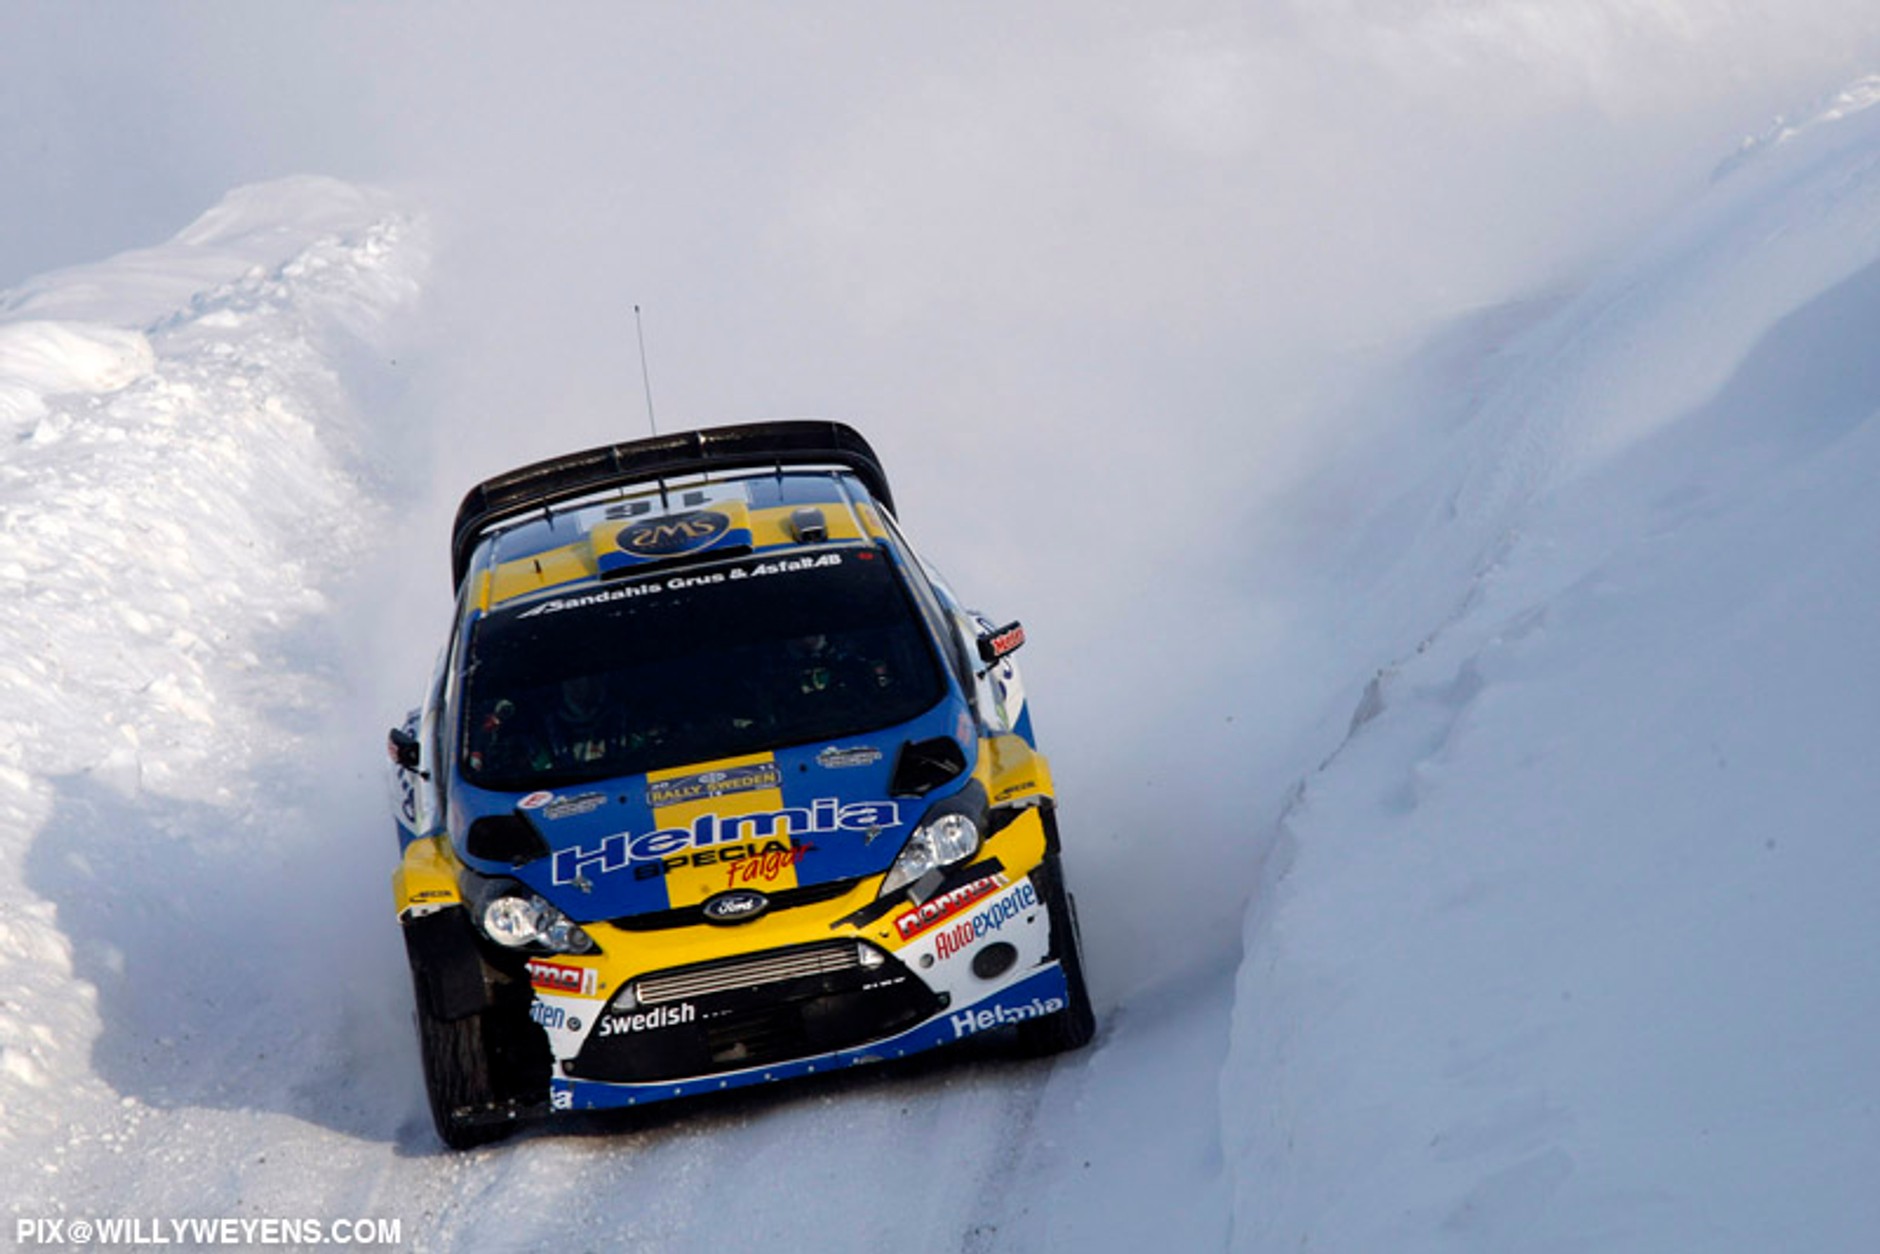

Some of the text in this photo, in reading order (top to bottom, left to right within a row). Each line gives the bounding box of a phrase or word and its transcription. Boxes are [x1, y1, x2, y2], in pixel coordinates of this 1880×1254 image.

[543, 583, 662, 615] Sandahls
[667, 572, 725, 590] Grus
[729, 568, 749, 580] &
[652, 773, 776, 803] RALLY SWEDEN
[551, 798, 903, 886] Helmia
[898, 878, 993, 935] norma
[935, 884, 1036, 960] Autoexperte
[525, 963, 580, 987] ma
[599, 1002, 695, 1036] Swedish
